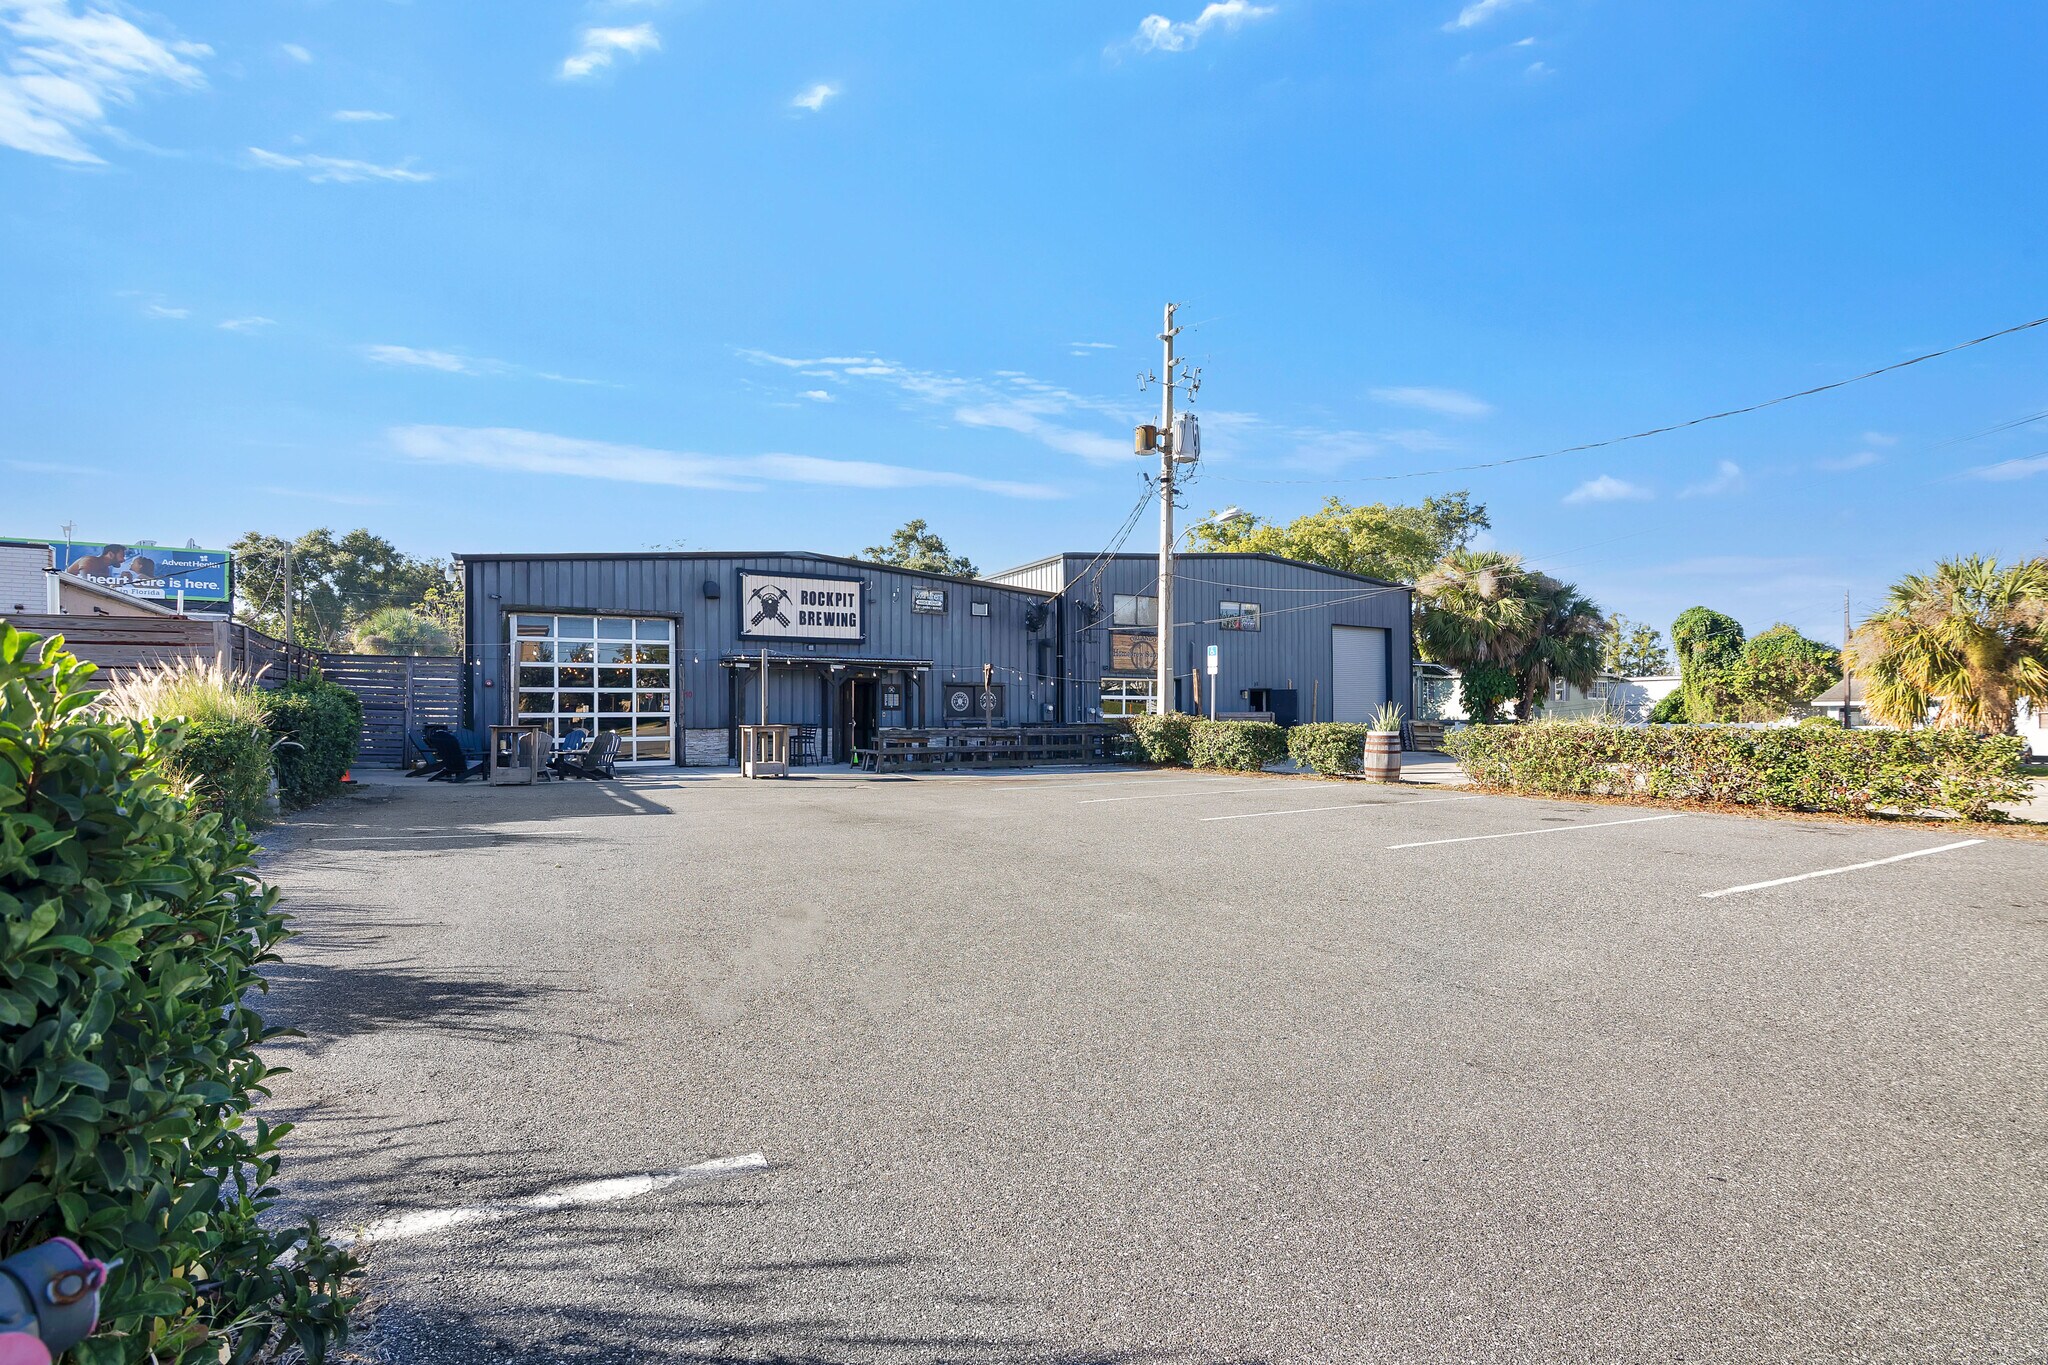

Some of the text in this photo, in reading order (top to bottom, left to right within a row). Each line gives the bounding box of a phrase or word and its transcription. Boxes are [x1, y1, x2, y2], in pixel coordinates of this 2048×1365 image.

[87, 573, 220, 590] heart care is here.
[131, 588, 160, 596] Florida
[800, 590, 855, 608] ROCKPIT
[799, 610, 857, 628] BREWING
